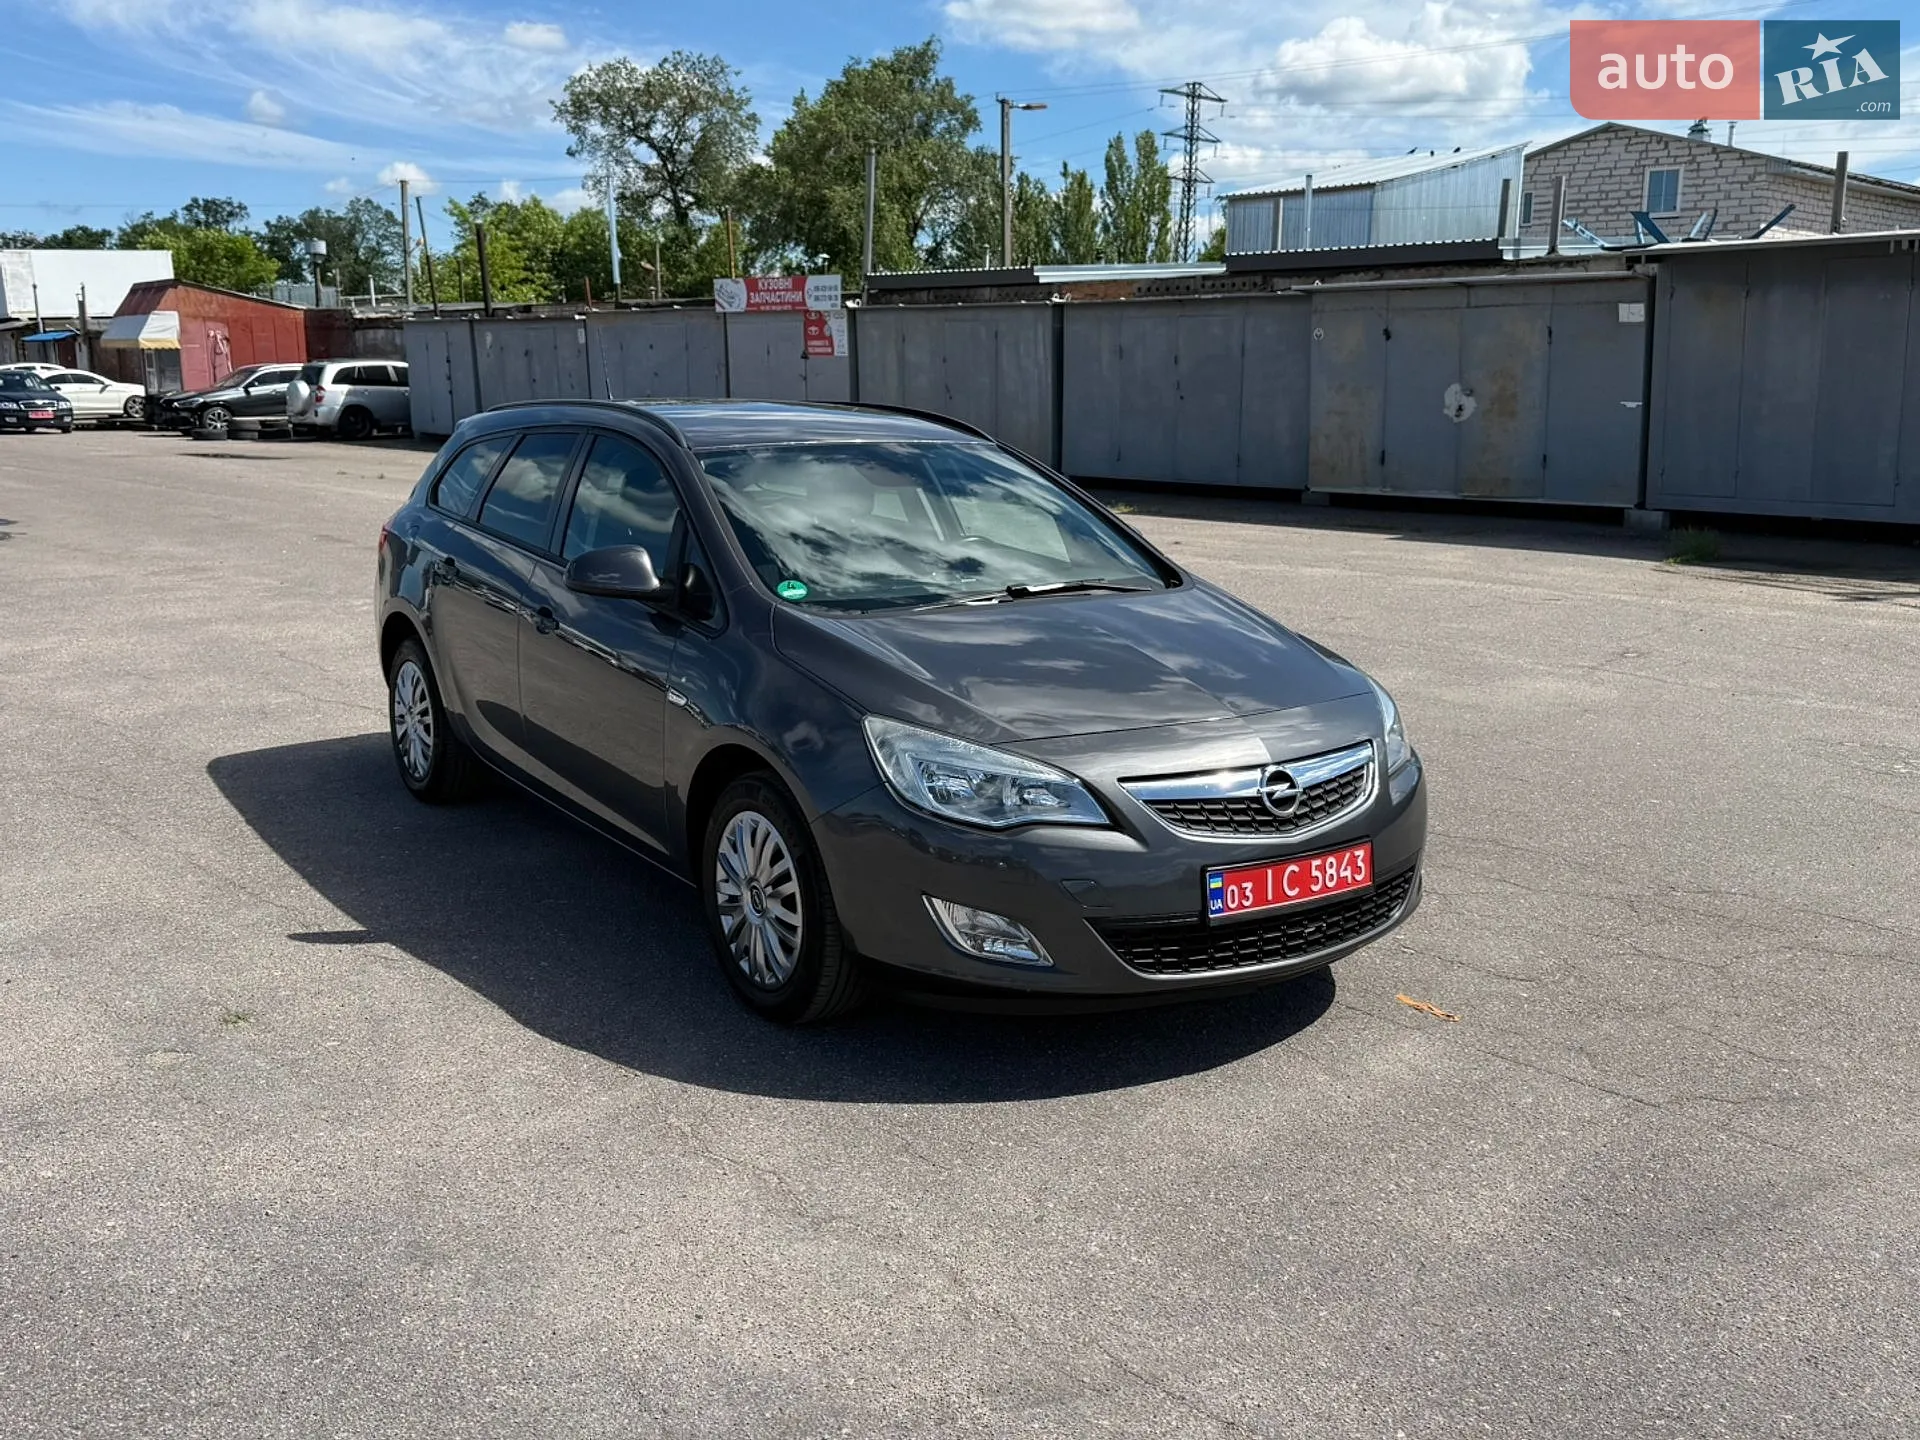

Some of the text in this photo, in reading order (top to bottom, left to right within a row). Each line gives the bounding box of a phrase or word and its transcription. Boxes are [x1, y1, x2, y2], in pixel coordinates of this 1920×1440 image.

[749, 291, 803, 304] ЗАПЧАСТИНИ
[1226, 881, 1254, 909] 03
[1310, 849, 1365, 892] 5843
[1210, 898, 1223, 911] UA
